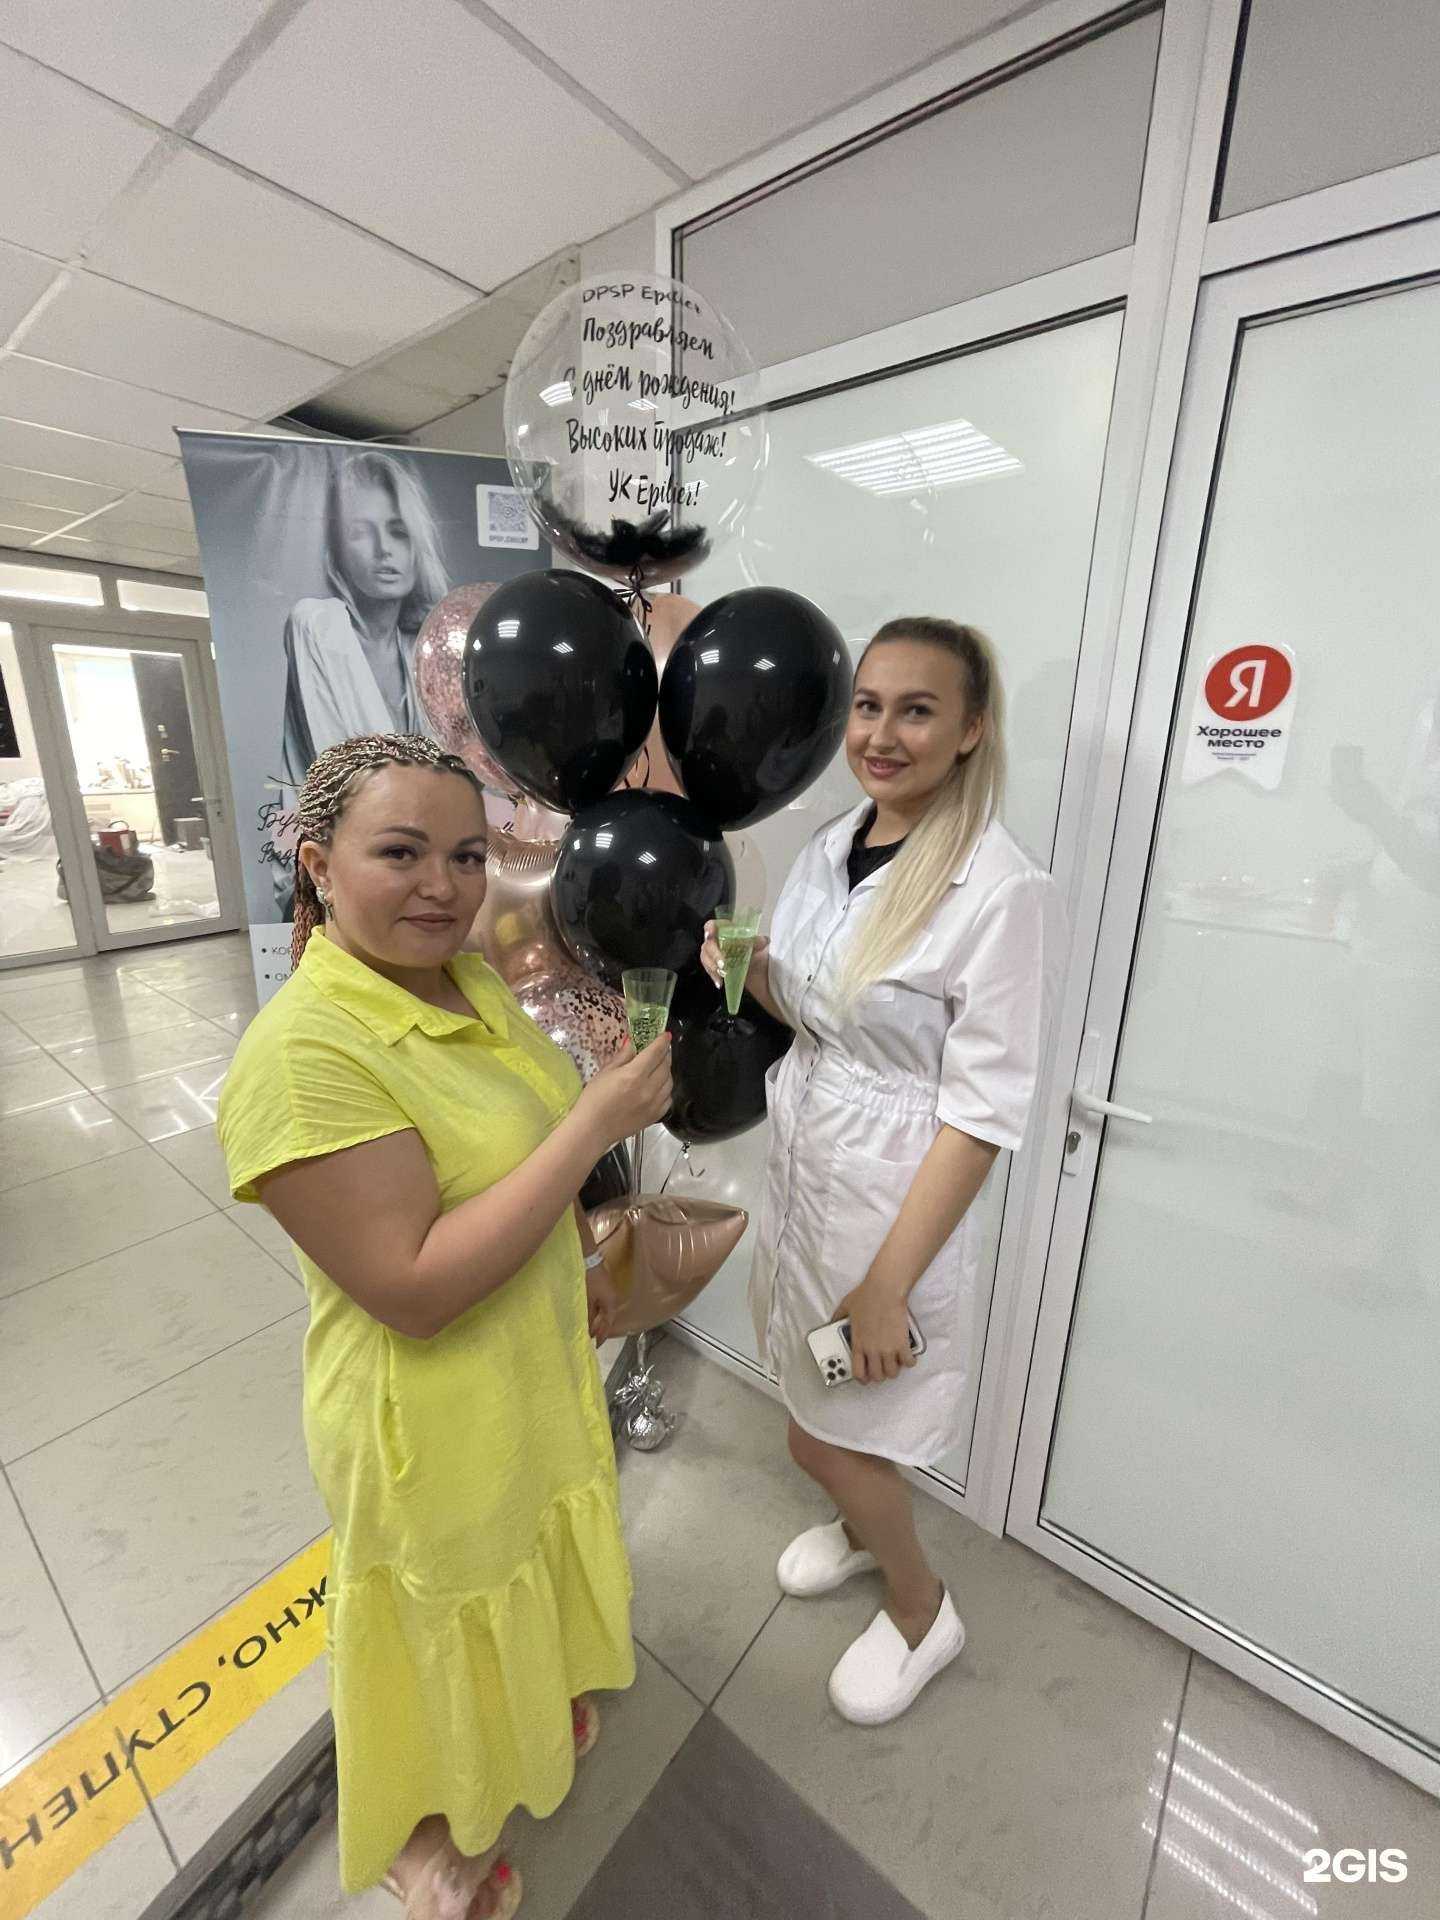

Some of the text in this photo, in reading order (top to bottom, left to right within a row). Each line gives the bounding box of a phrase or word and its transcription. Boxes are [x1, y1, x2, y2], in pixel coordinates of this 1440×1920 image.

[582, 283, 634, 303] DPSP
[583, 317, 714, 360] Поздравляем
[583, 364, 632, 405] днём
[639, 370, 736, 416] рождения!
[566, 418, 647, 454] Высоких
[1224, 659, 1267, 708] Я
[1196, 725, 1282, 738] Хорошее
[1207, 739, 1265, 749] место
